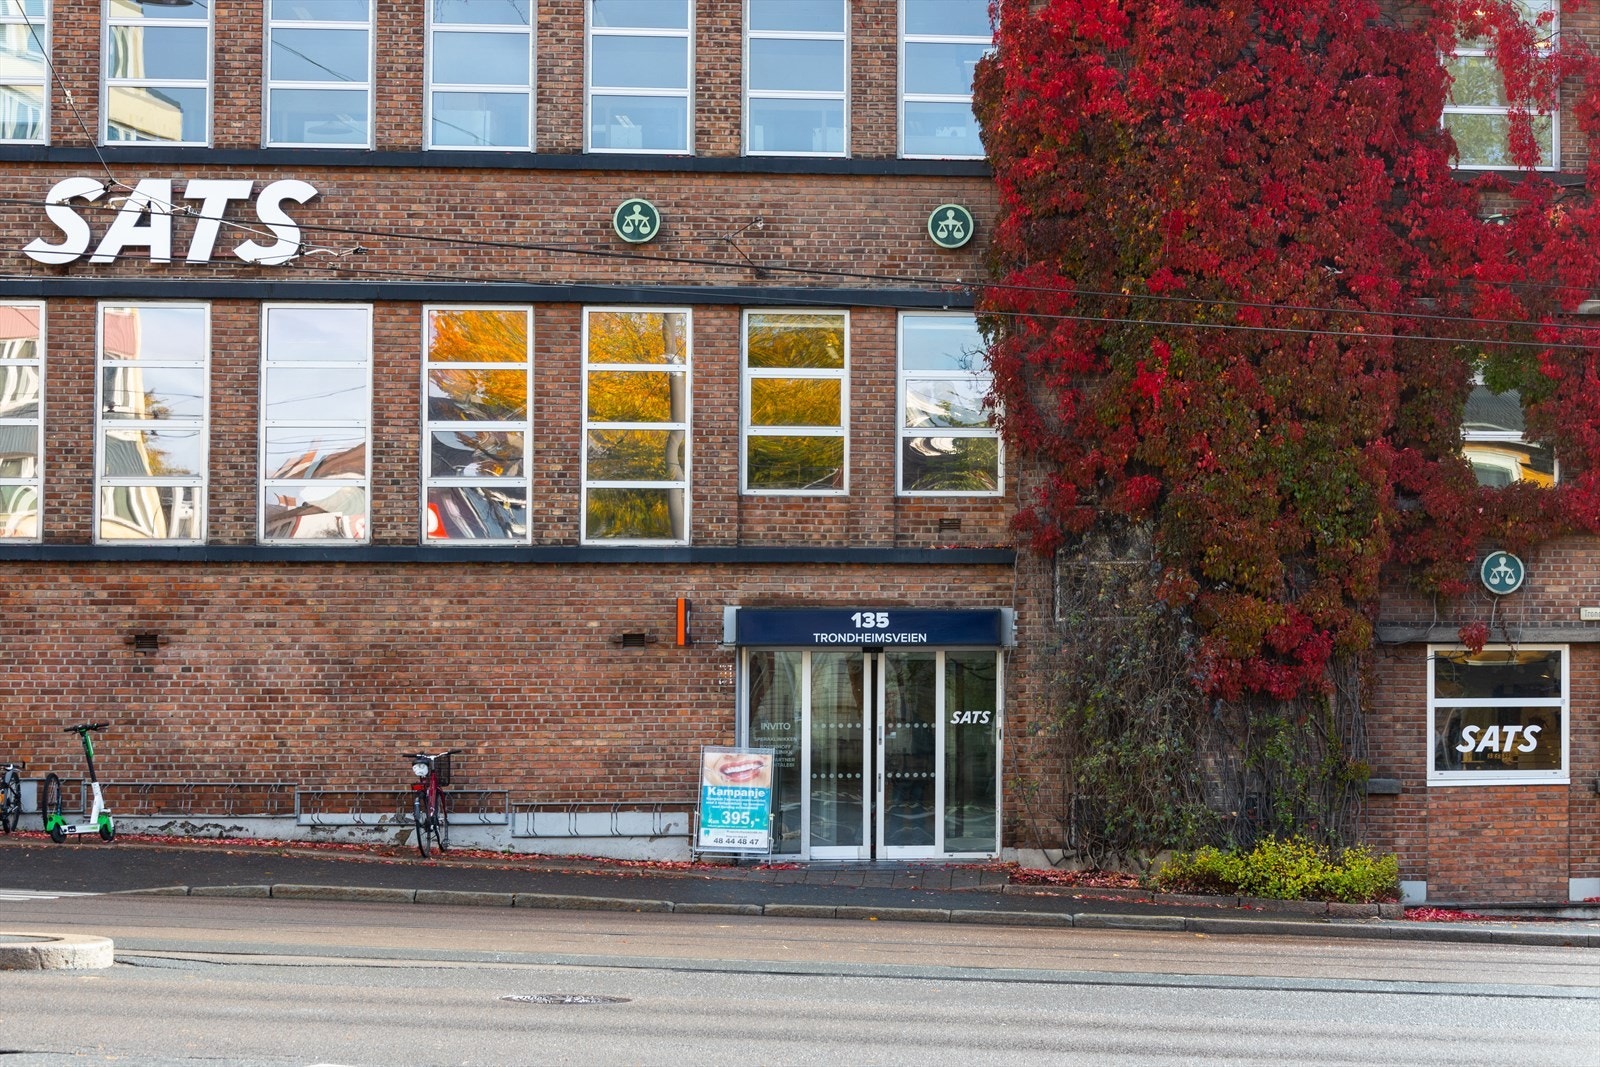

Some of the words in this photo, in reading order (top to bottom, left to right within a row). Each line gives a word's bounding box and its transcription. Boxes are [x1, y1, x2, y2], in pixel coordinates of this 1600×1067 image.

[23, 177, 319, 265] SATS
[850, 612, 890, 629] 135
[812, 632, 927, 644] TRONDHEIMSVEIEN
[950, 710, 991, 725] SATS
[760, 722, 791, 731] INVITO
[1455, 724, 1542, 753] SATS
[707, 786, 766, 799] Kampanje
[721, 810, 760, 828] 395,-
